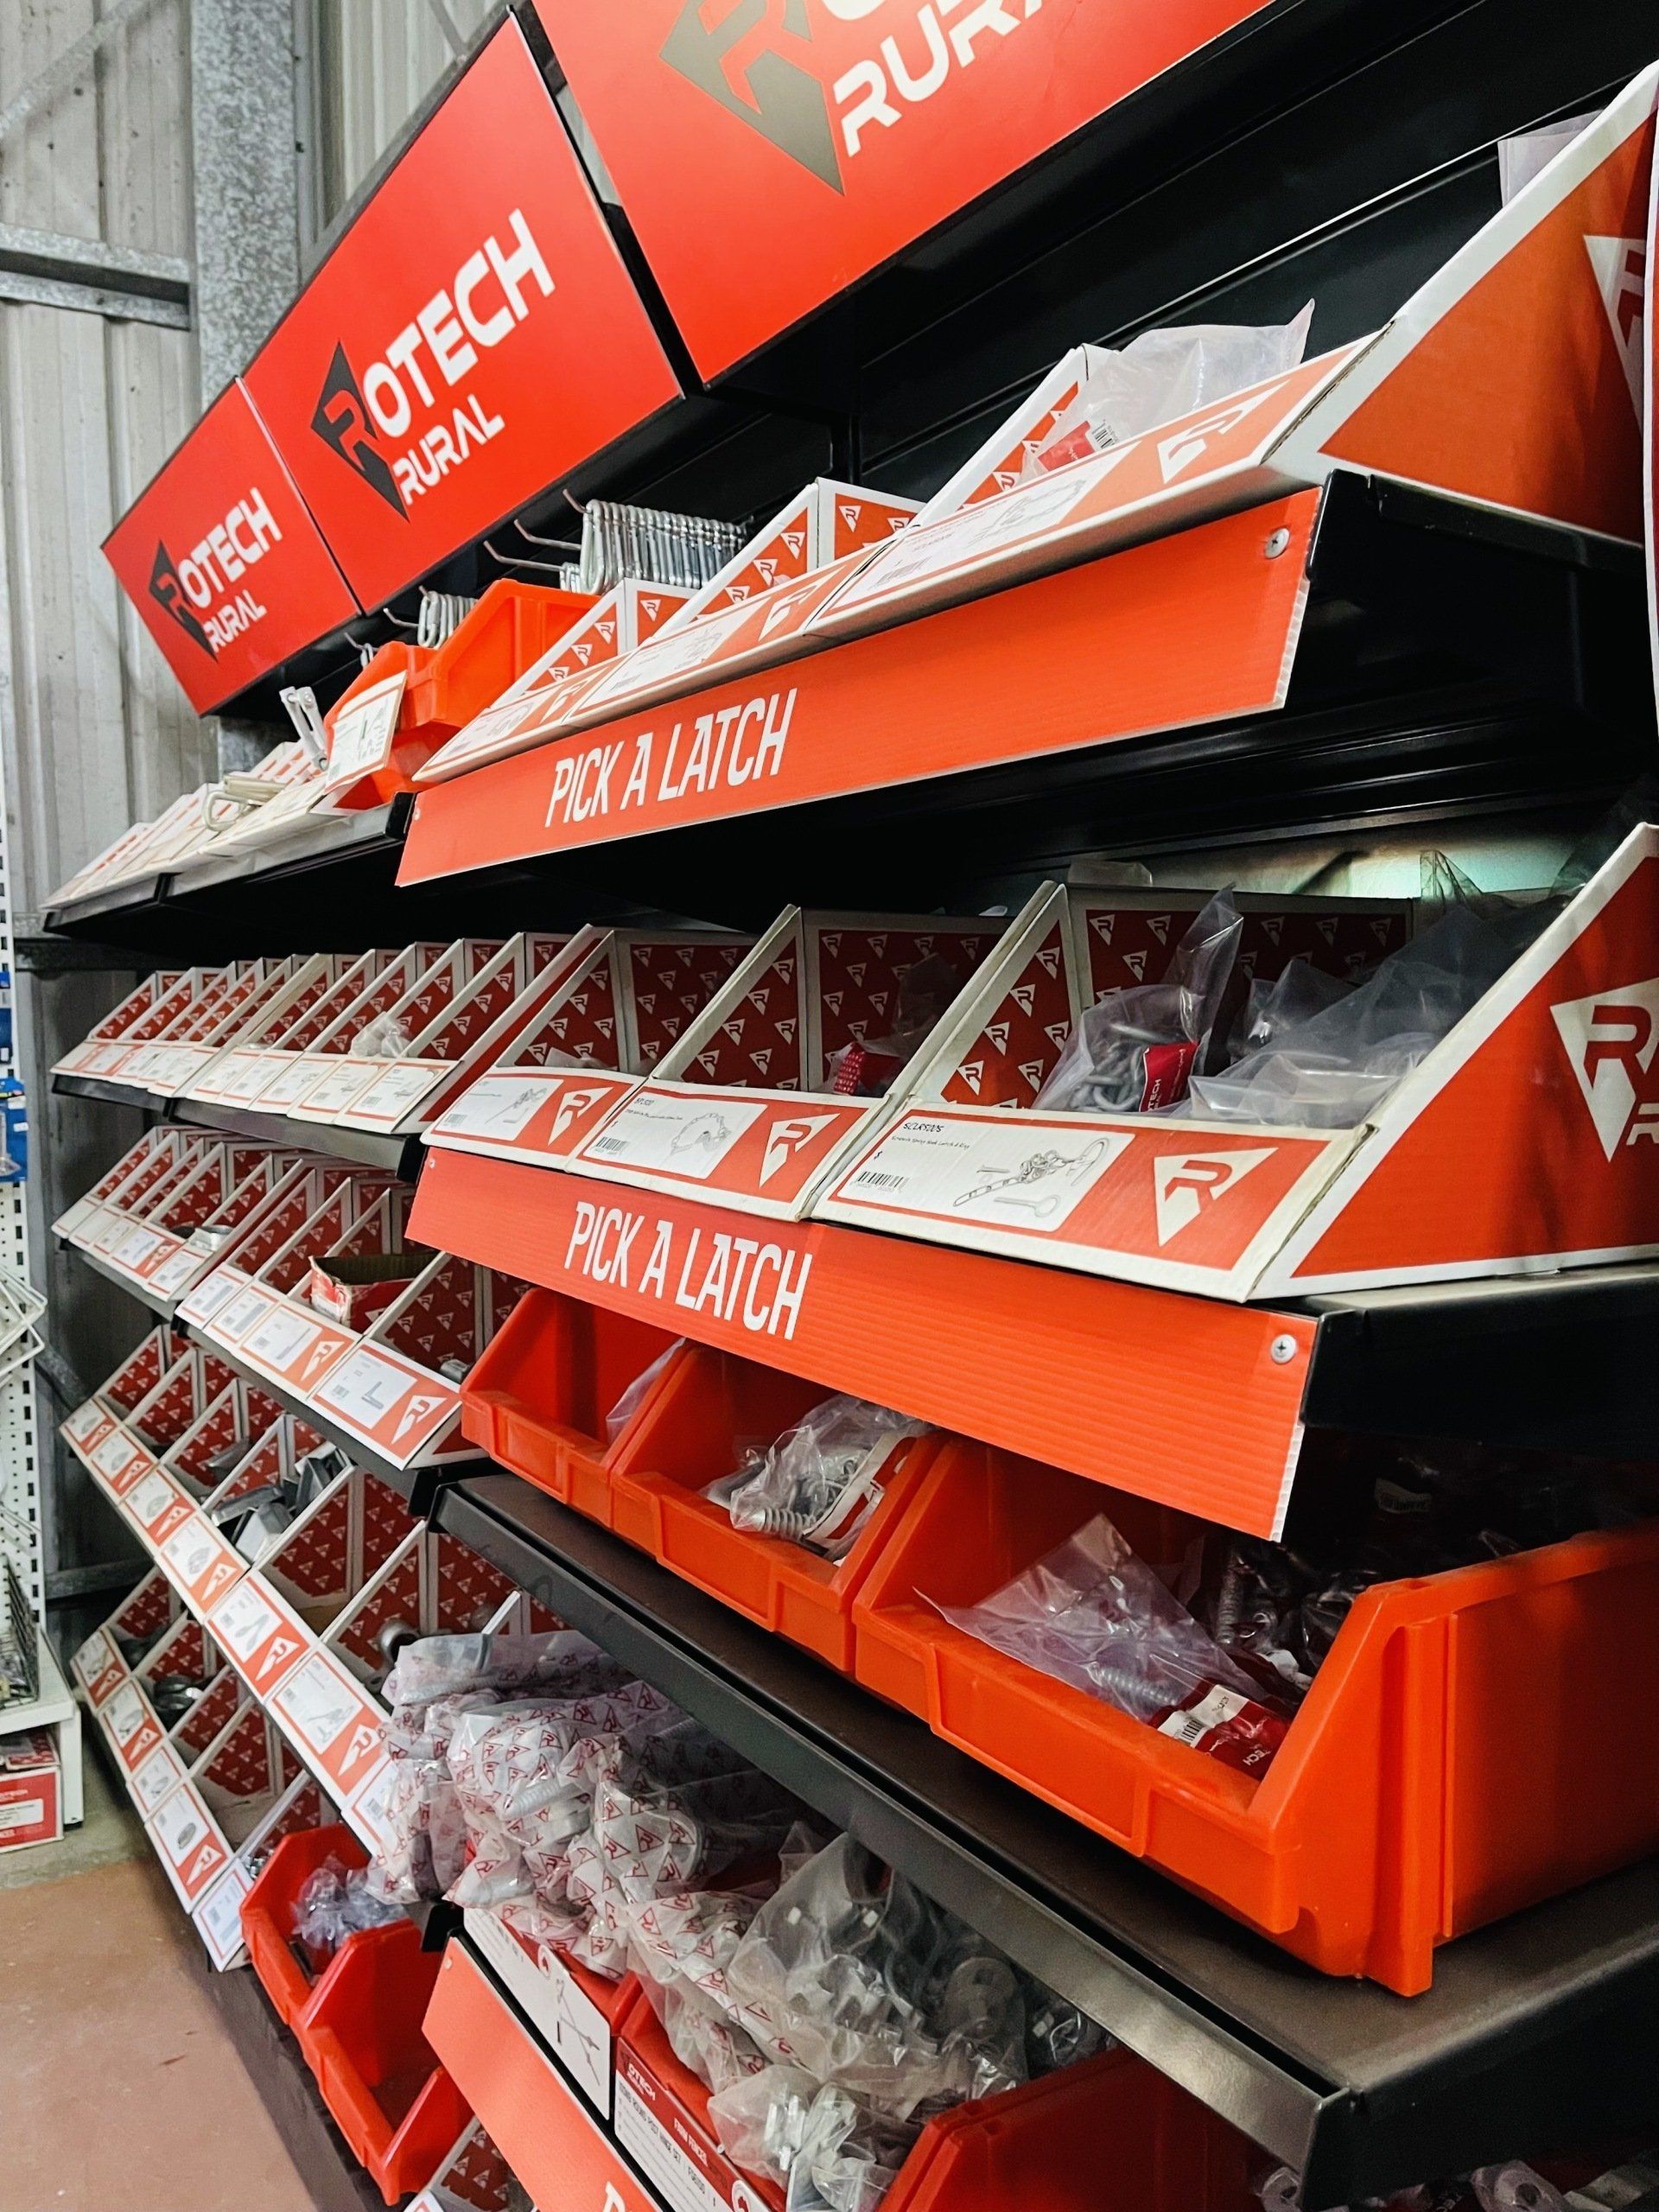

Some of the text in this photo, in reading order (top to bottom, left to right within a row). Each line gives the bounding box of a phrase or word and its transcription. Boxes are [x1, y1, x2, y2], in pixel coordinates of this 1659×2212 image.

[392, 394, 505, 505] RURAL
[202, 588, 268, 653] RURAL
[543, 687, 798, 829] PICK A LATCH
[563, 1201, 814, 1341] PICK A LATCH
